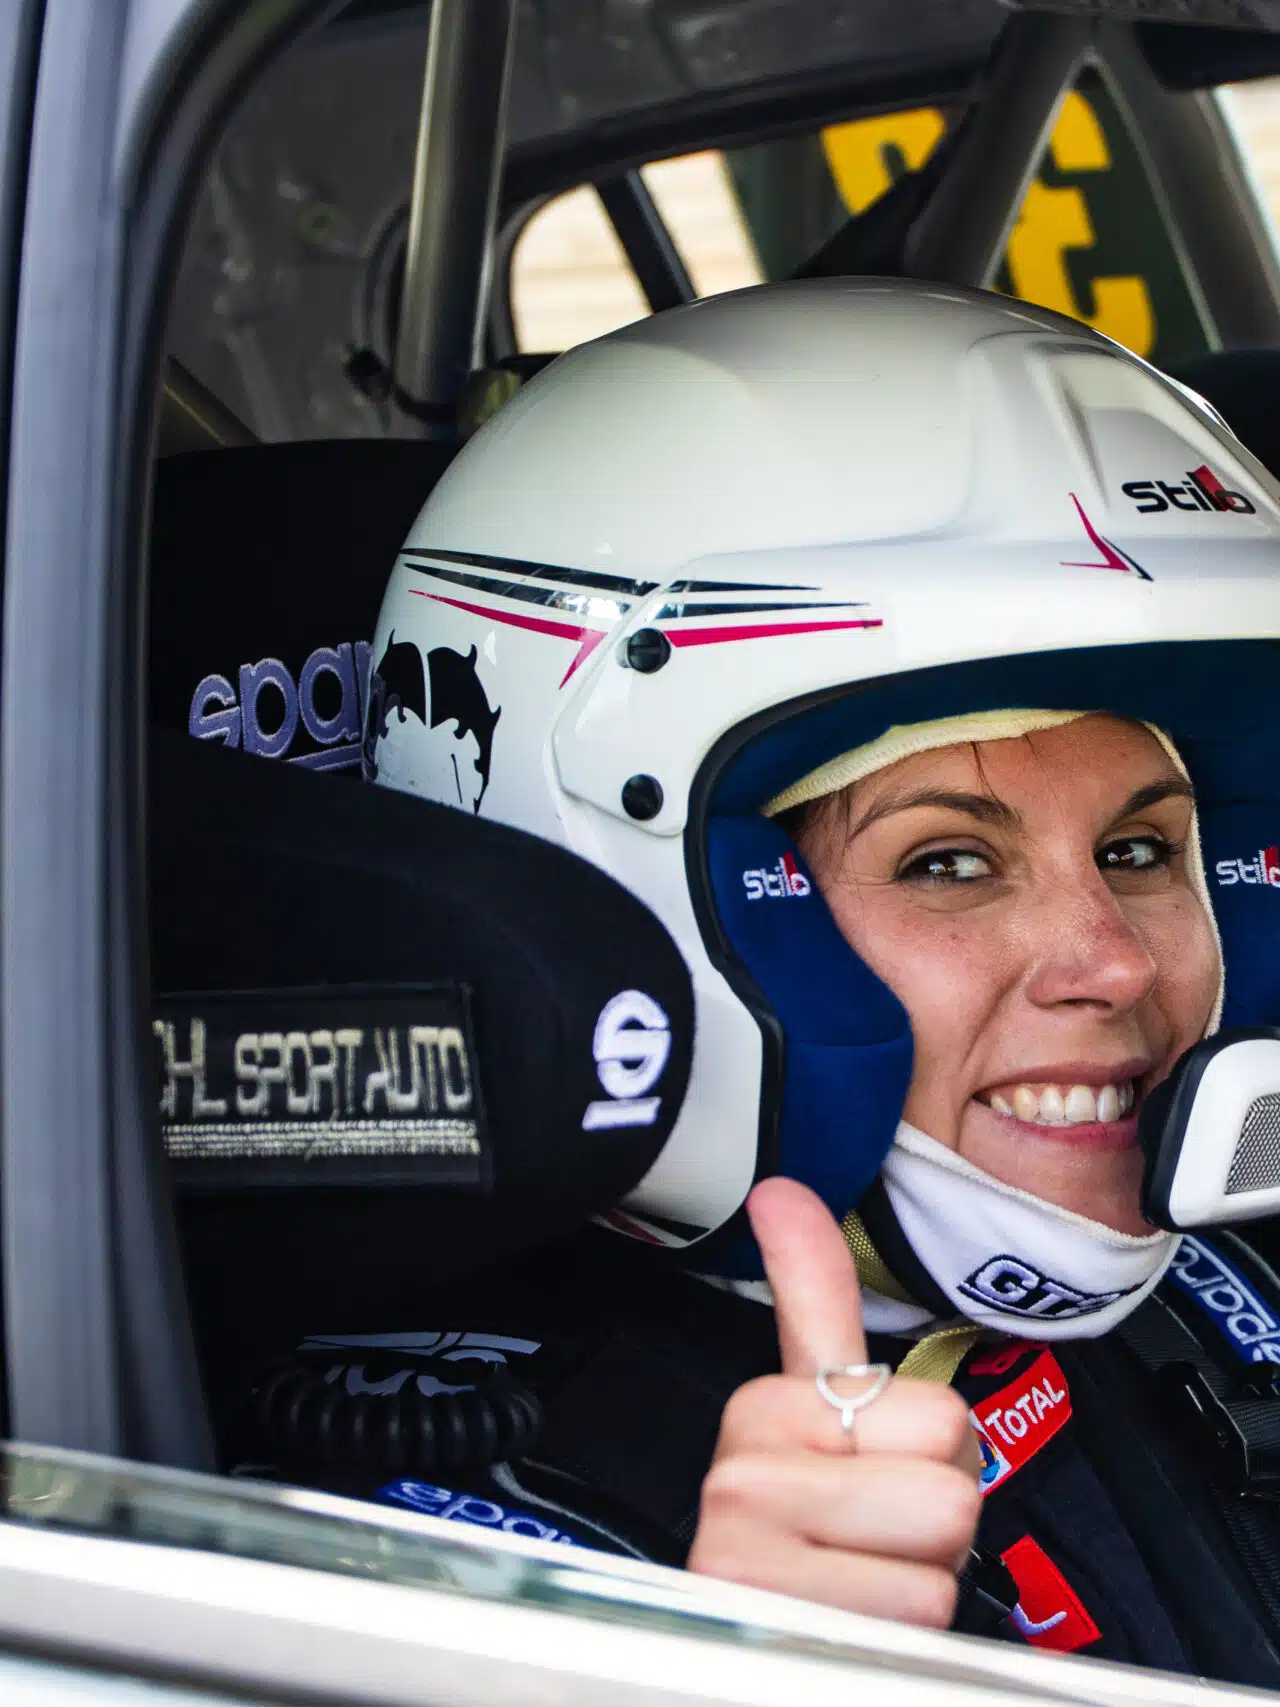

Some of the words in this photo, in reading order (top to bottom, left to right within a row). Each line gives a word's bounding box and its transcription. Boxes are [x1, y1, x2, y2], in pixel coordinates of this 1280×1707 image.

[235, 1028, 364, 1117] SPORT
[362, 1025, 472, 1114] AUTO
[983, 1376, 1067, 1446] TOTAL
